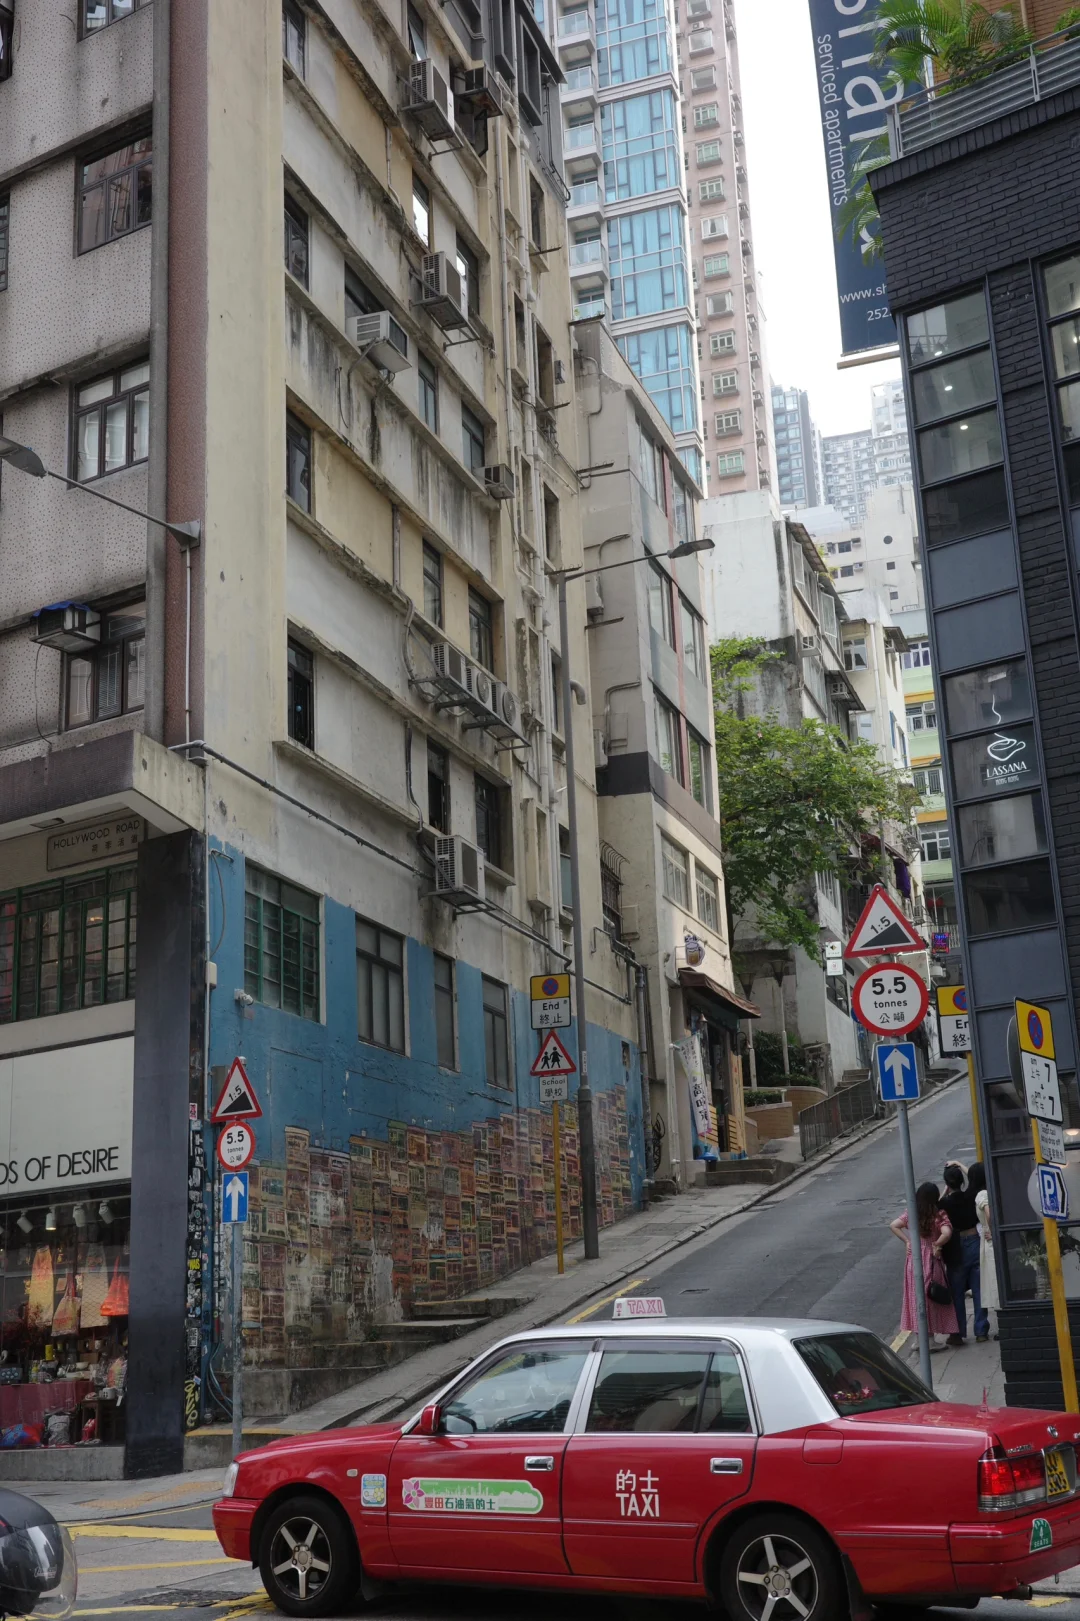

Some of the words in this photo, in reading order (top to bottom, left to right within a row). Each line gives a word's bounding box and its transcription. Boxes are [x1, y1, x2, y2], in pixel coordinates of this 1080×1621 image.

[817, 34, 842, 104] serviced
[821, 109, 850, 206] apartments
[866, 306, 892, 321] 252
[986, 760, 1027, 778] LASSANA
[53, 828, 110, 850] HOLLYWOOD
[116, 820, 140, 834] ROAD
[871, 916, 891, 934] 1:5
[872, 976, 907, 996] 5.5
[542, 1002, 560, 1011] End
[874, 1000, 908, 1009] tonnes
[540, 1013, 563, 1025] 終止
[879, 1012, 905, 1024] 公噸
[1044, 1063, 1050, 1082] 7
[229, 1085, 242, 1101] 1:5
[544, 1088, 563, 1098] 學校
[1048, 1096, 1054, 1116] 7
[226, 1131, 244, 1144] 5.5
[25, 1156, 51, 1181] OF
[57, 1146, 119, 1177] DESIRE
[627, 1300, 663, 1314] TAXI
[616, 1469, 659, 1492] 的士
[616, 1493, 660, 1517] TAXI
[1034, 1538, 1048, 1548] SEATS
